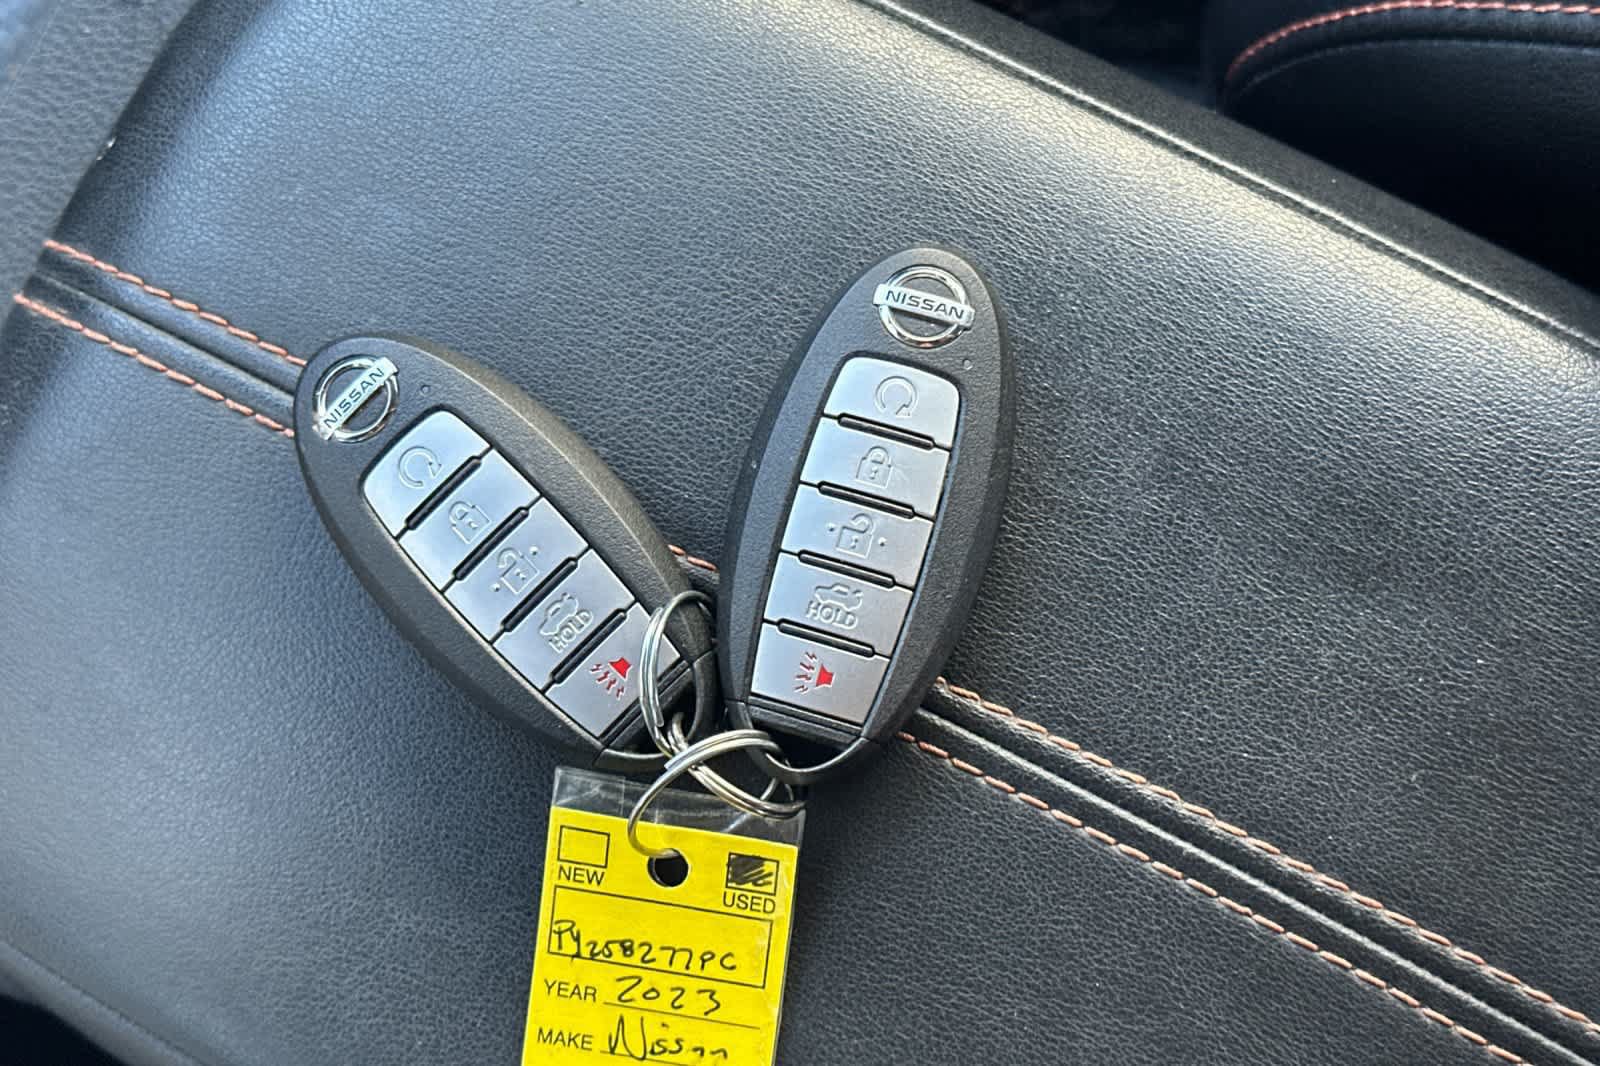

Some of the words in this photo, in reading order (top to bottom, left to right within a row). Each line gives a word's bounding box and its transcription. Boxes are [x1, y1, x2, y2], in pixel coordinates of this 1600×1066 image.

[885, 289, 965, 320] NISSAN
[323, 367, 385, 429] NISSAN
[805, 600, 858, 630] HOLD
[548, 608, 594, 653] HOLD
[557, 865, 605, 886] NEW
[722, 893, 776, 914] USED
[543, 978, 597, 1003] YEAR
[615, 975, 721, 1016] 2023
[536, 1027, 594, 1050] MAKE
